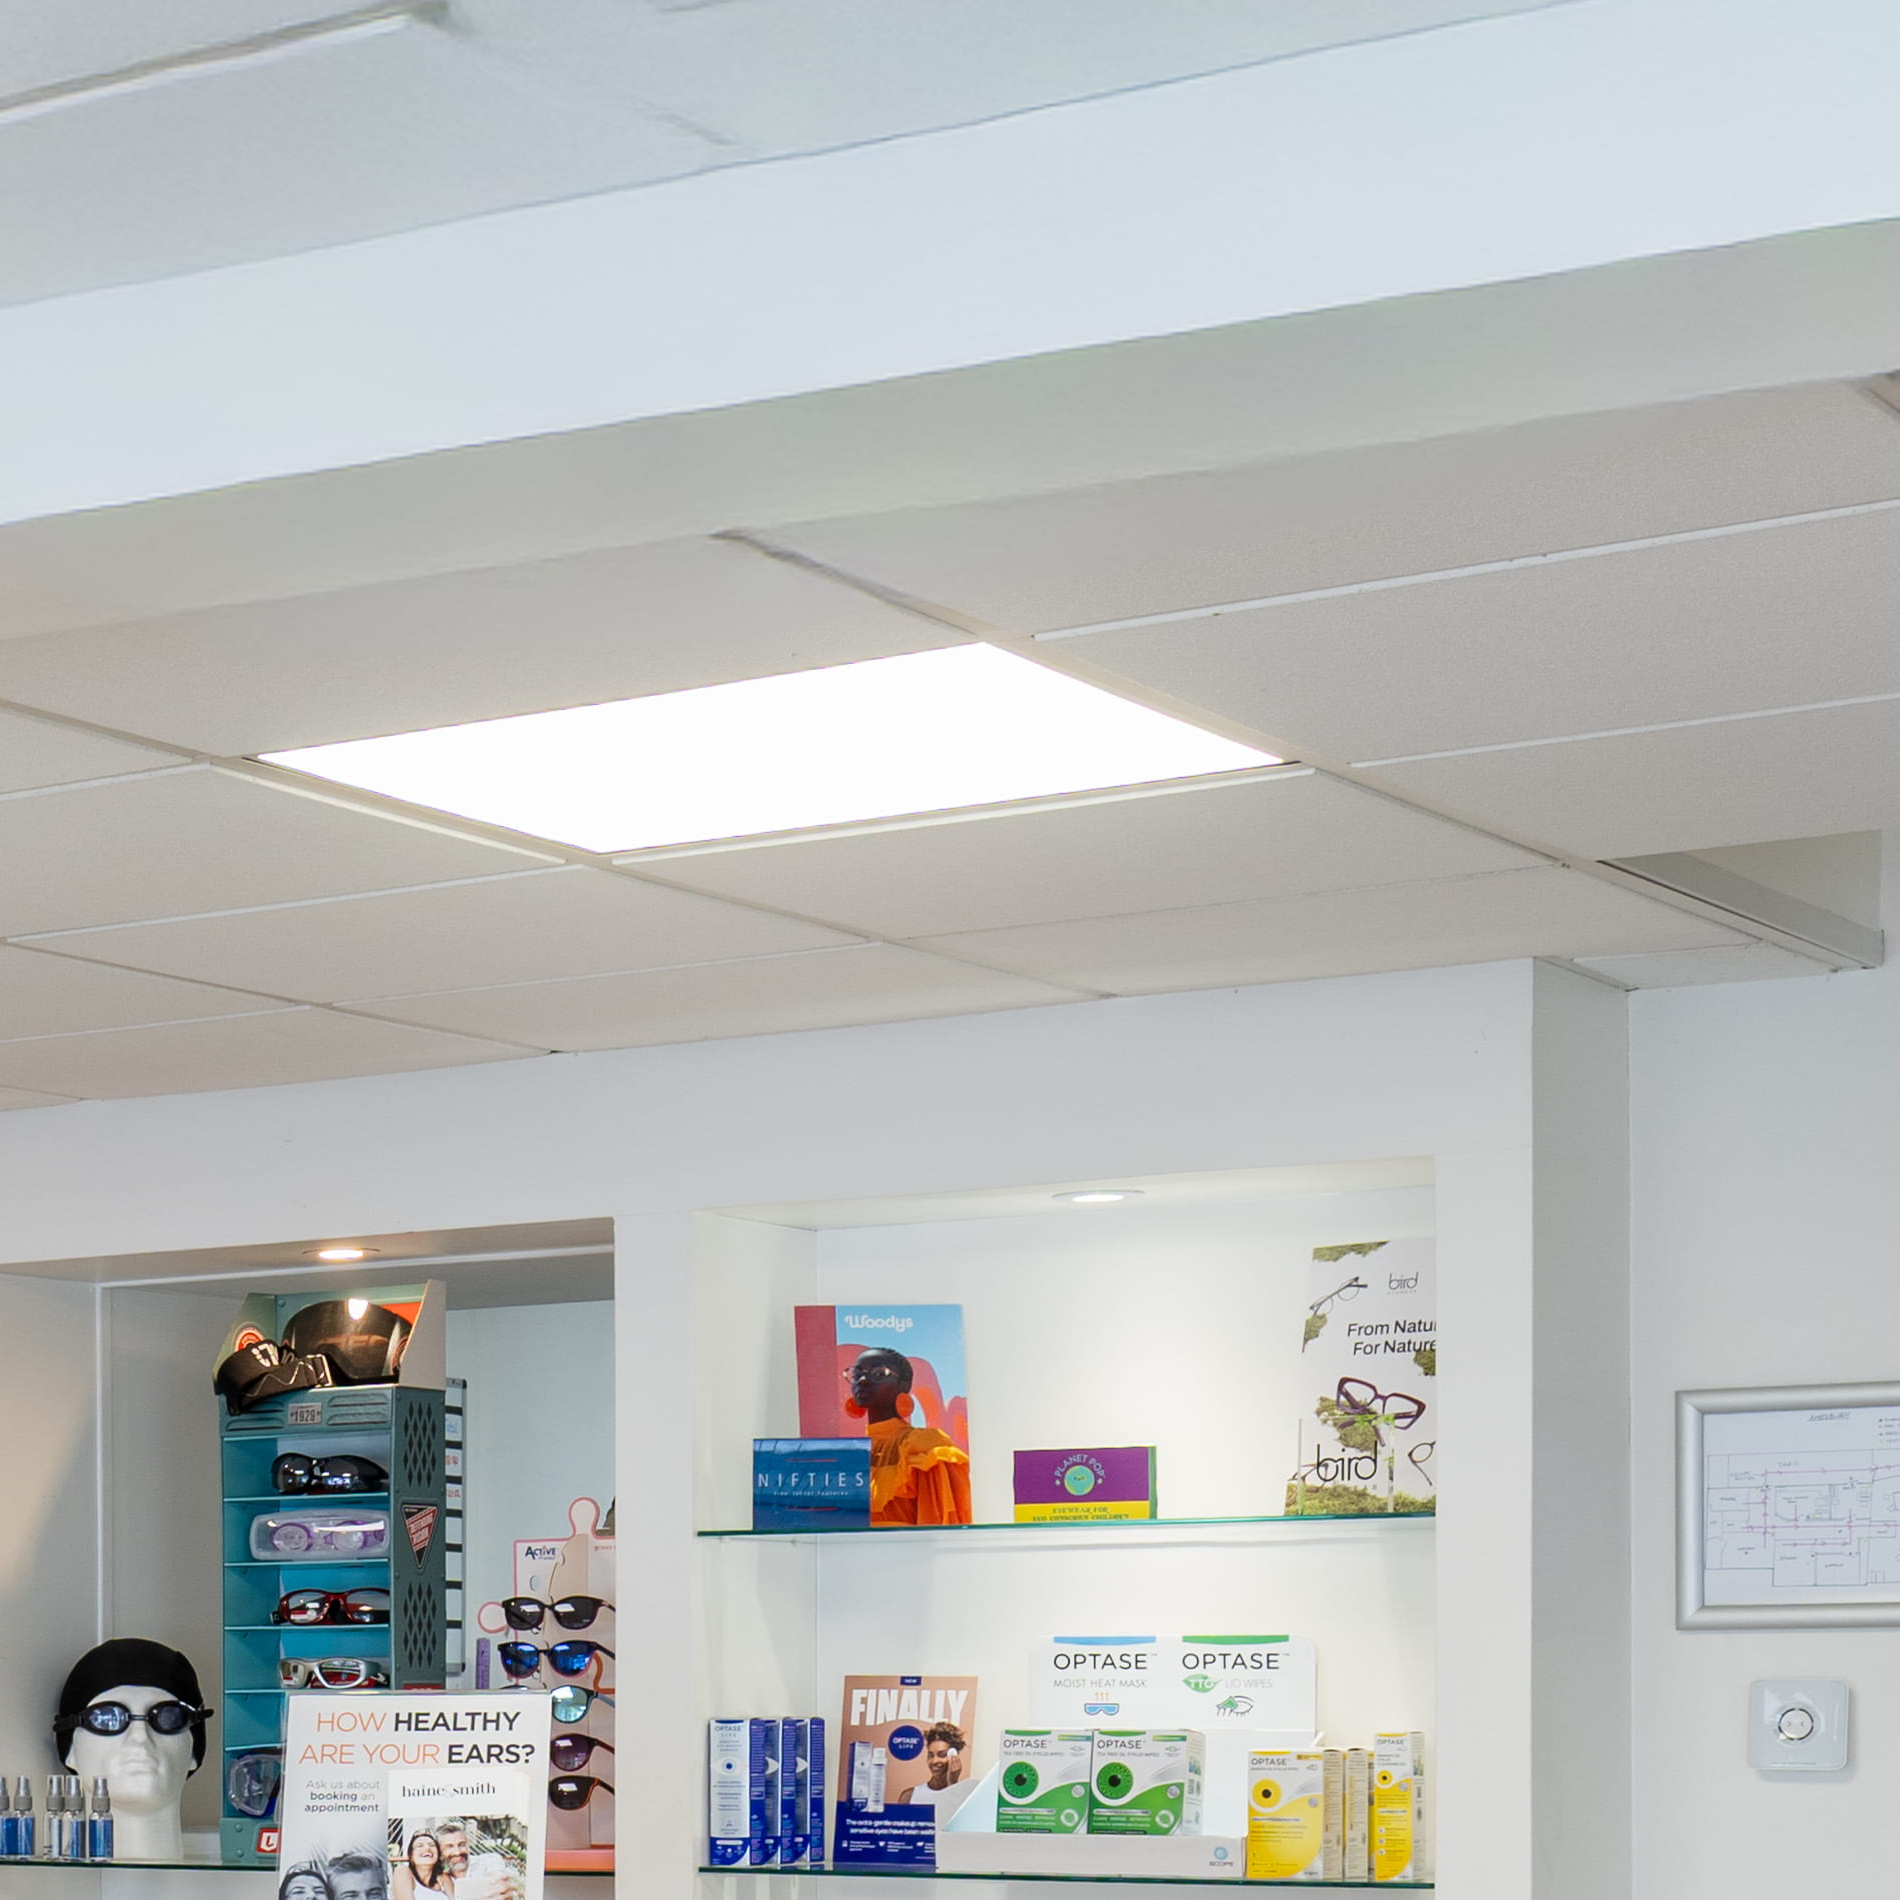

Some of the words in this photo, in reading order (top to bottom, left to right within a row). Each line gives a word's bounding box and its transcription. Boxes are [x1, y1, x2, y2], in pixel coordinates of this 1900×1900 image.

[1388, 1271, 1419, 1291] bird
[844, 1315, 914, 1332] Woodys
[1347, 1322, 1390, 1337] From
[1353, 1341, 1381, 1356] For
[1053, 1453, 1088, 1478] PLANET
[1088, 1458, 1105, 1478] POP
[1316, 1440, 1378, 1482] bird
[757, 1472, 865, 1488] NIFTIES
[1053, 1652, 1148, 1671] OPTASE
[1182, 1652, 1281, 1671] OPTASE
[1053, 1678, 1087, 1689] MOIST
[1090, 1678, 1117, 1689] HEAT
[1119, 1678, 1148, 1688] MASK
[1224, 1678, 1243, 1689] LID
[1243, 1678, 1274, 1689] WIPES
[850, 1688, 969, 1727] FINALLY
[315, 1711, 388, 1733] HOW
[393, 1710, 522, 1732] HEALTHY
[1003, 1739, 1048, 1749] OPTASE
[1096, 1739, 1142, 1750] OPTASE
[298, 1743, 356, 1765] ARE
[362, 1743, 441, 1765] YOUR
[446, 1743, 536, 1765] EARS?
[1250, 1757, 1288, 1766] OPTASE
[305, 1779, 327, 1790] Ask
[329, 1781, 345, 1790] us
[346, 1779, 381, 1790] about
[309, 1790, 358, 1803] booking
[303, 1802, 381, 1814] appointment
